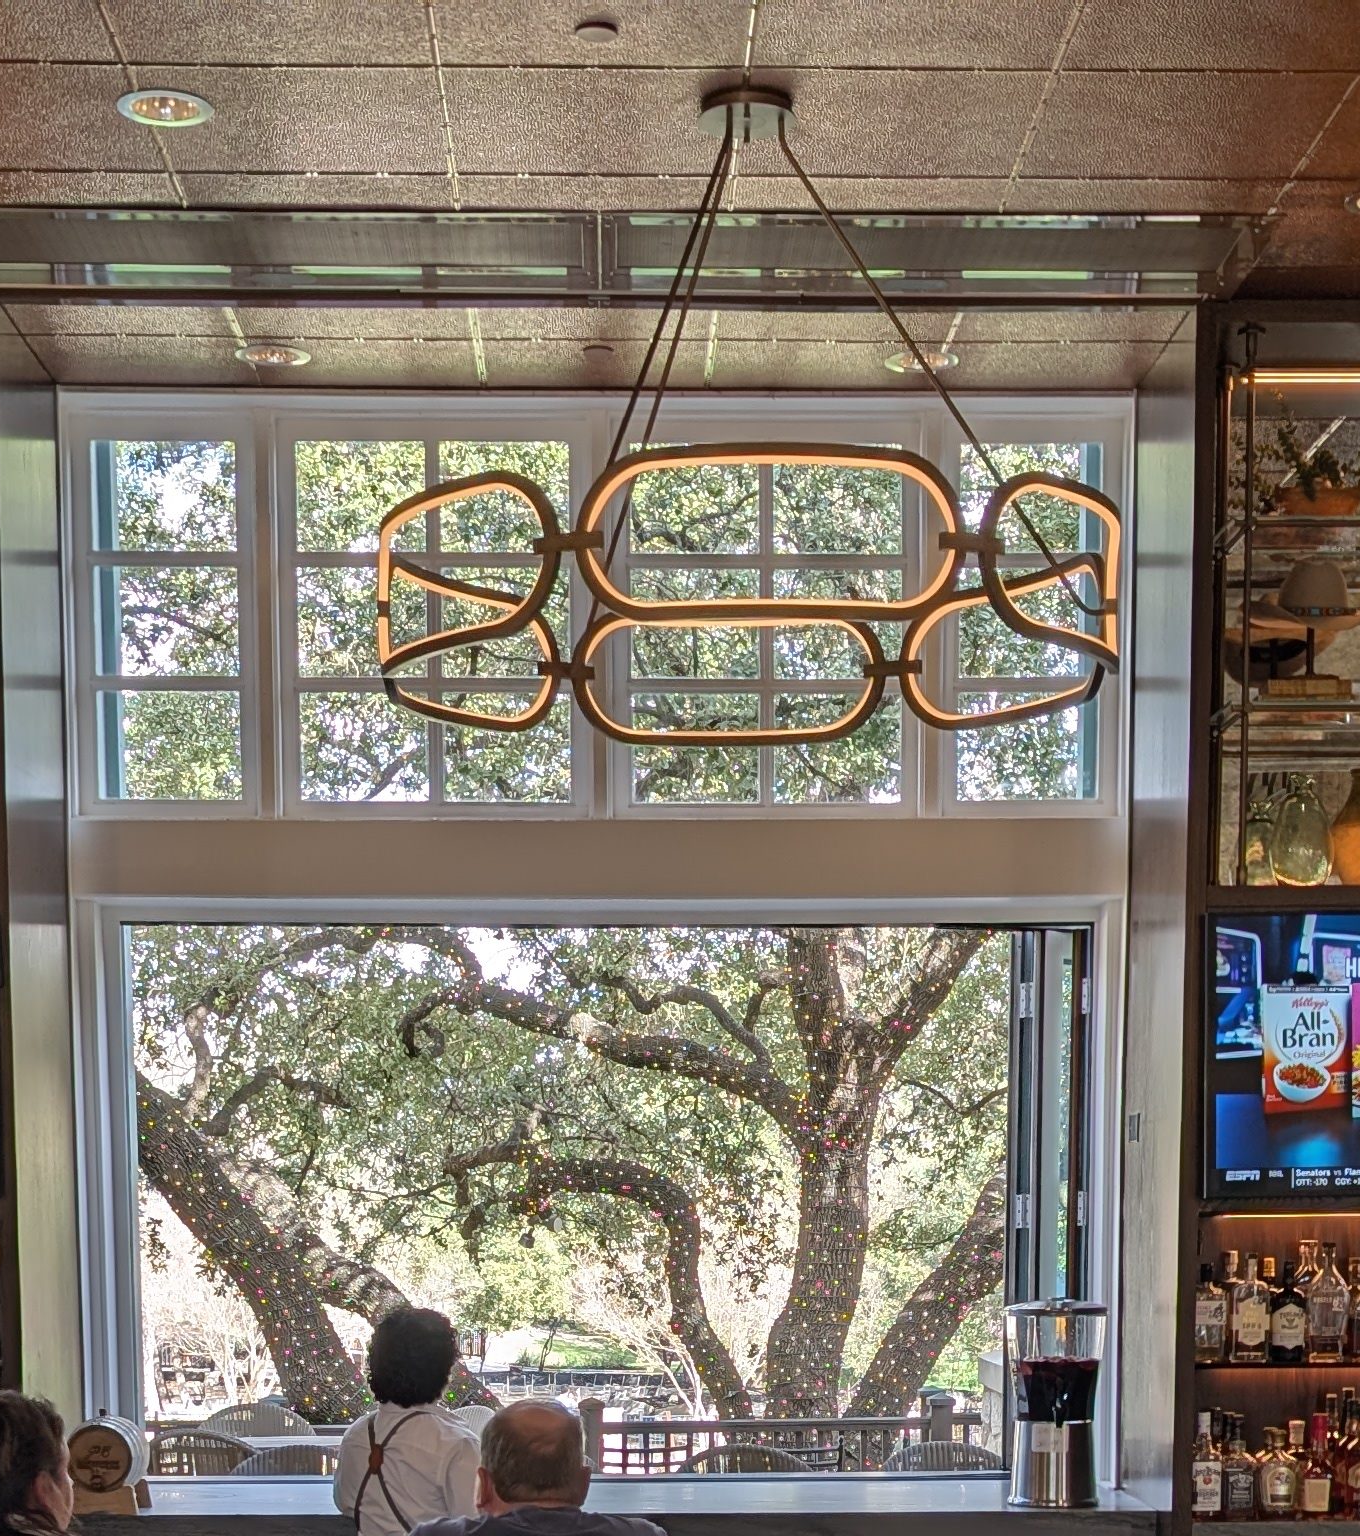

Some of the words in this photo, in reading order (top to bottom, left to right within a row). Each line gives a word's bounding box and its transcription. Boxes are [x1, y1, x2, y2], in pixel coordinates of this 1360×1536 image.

[1294, 1011, 1330, 1031] All-
[1282, 1028, 1335, 1048] Bran
[1293, 1050, 1326, 1060] Original
[1226, 1170, 1260, 1181] ESPN
[1296, 1169, 1331, 1177] Senators
